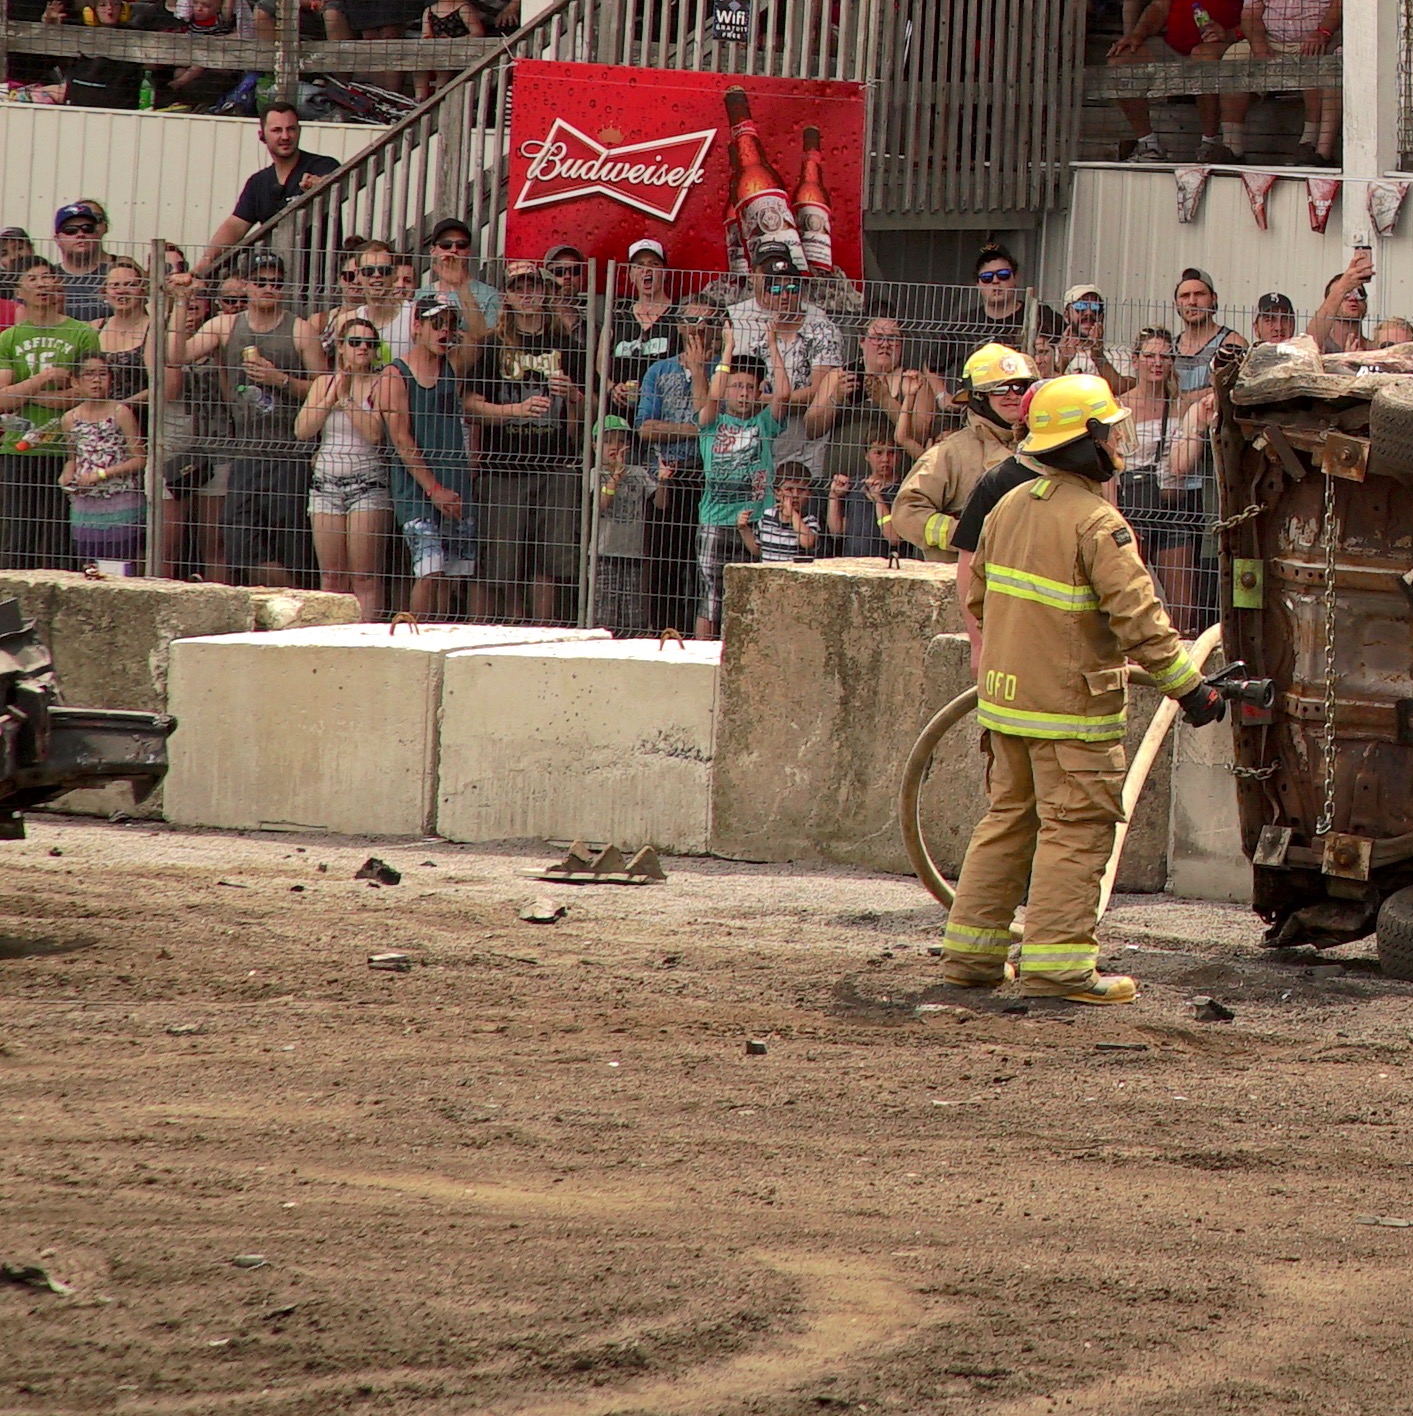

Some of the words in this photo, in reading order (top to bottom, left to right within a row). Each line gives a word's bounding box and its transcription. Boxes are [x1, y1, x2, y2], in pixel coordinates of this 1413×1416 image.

[716, 9, 746, 26] Wifi
[520, 139, 705, 189] Budweiser
[986, 669, 1017, 701] OFD
